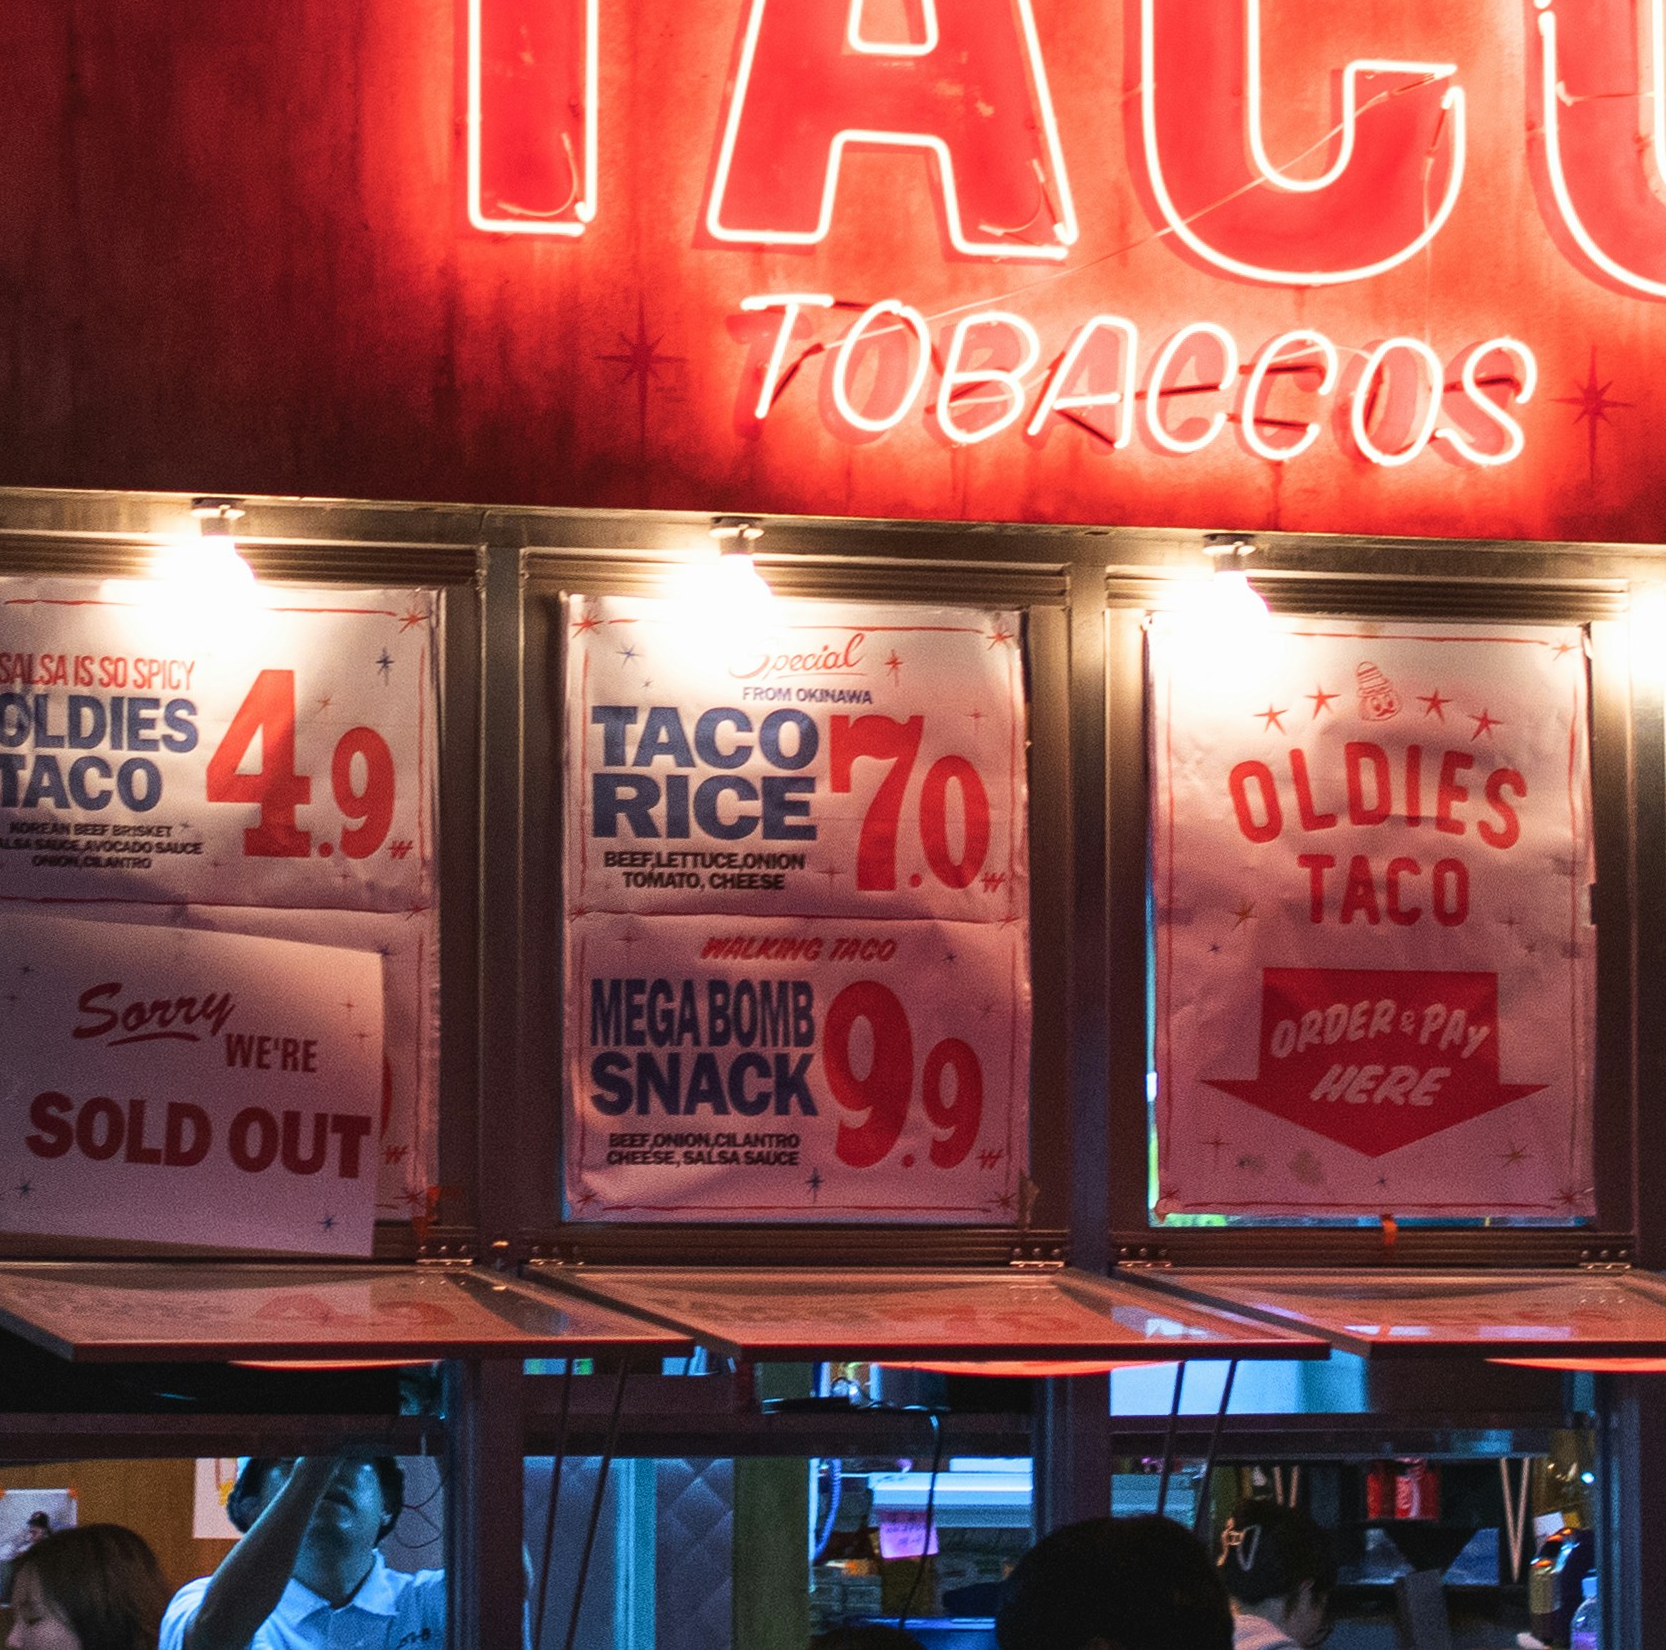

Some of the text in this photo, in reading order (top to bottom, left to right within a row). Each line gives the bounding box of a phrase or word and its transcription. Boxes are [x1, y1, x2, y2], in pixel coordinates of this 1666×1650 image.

[739, 290, 1539, 468] TOBACCOS
[74, 656, 93, 688] IS
[99, 657, 129, 689] SO
[134, 659, 196, 691] SPICY
[729, 632, 868, 680] Special
[742, 686, 873, 705] FROM OKINAWA
[206, 669, 396, 859] 4.9
[591, 705, 819, 770] TACO
[591, 773, 817, 842] RICE
[829, 714, 990, 892] 7.0
[1228, 741, 1528, 850] OLDIES
[10, 822, 172, 838] KOREAN BEEF BRISKET
[155, 842, 203, 855] SAUCE
[622, 872, 785, 891] TOMATO, CHEESE
[1297, 853, 1469, 928] TACO
[700, 937, 896, 962] WALKING TACO
[73, 981, 235, 1042] Sorry
[590, 978, 815, 1049] MEGA BOMB
[1270, 998, 1397, 1059] ORDER
[224, 1033, 318, 1074] WE'RE
[591, 1051, 819, 1117] SNACK
[823, 980, 983, 1170] 9.9
[1309, 1063, 1452, 1107] HERE
[25, 1091, 373, 1179] SOLD OUT
[607, 1150, 799, 1167] CHEESE, SALSA SAUCE
